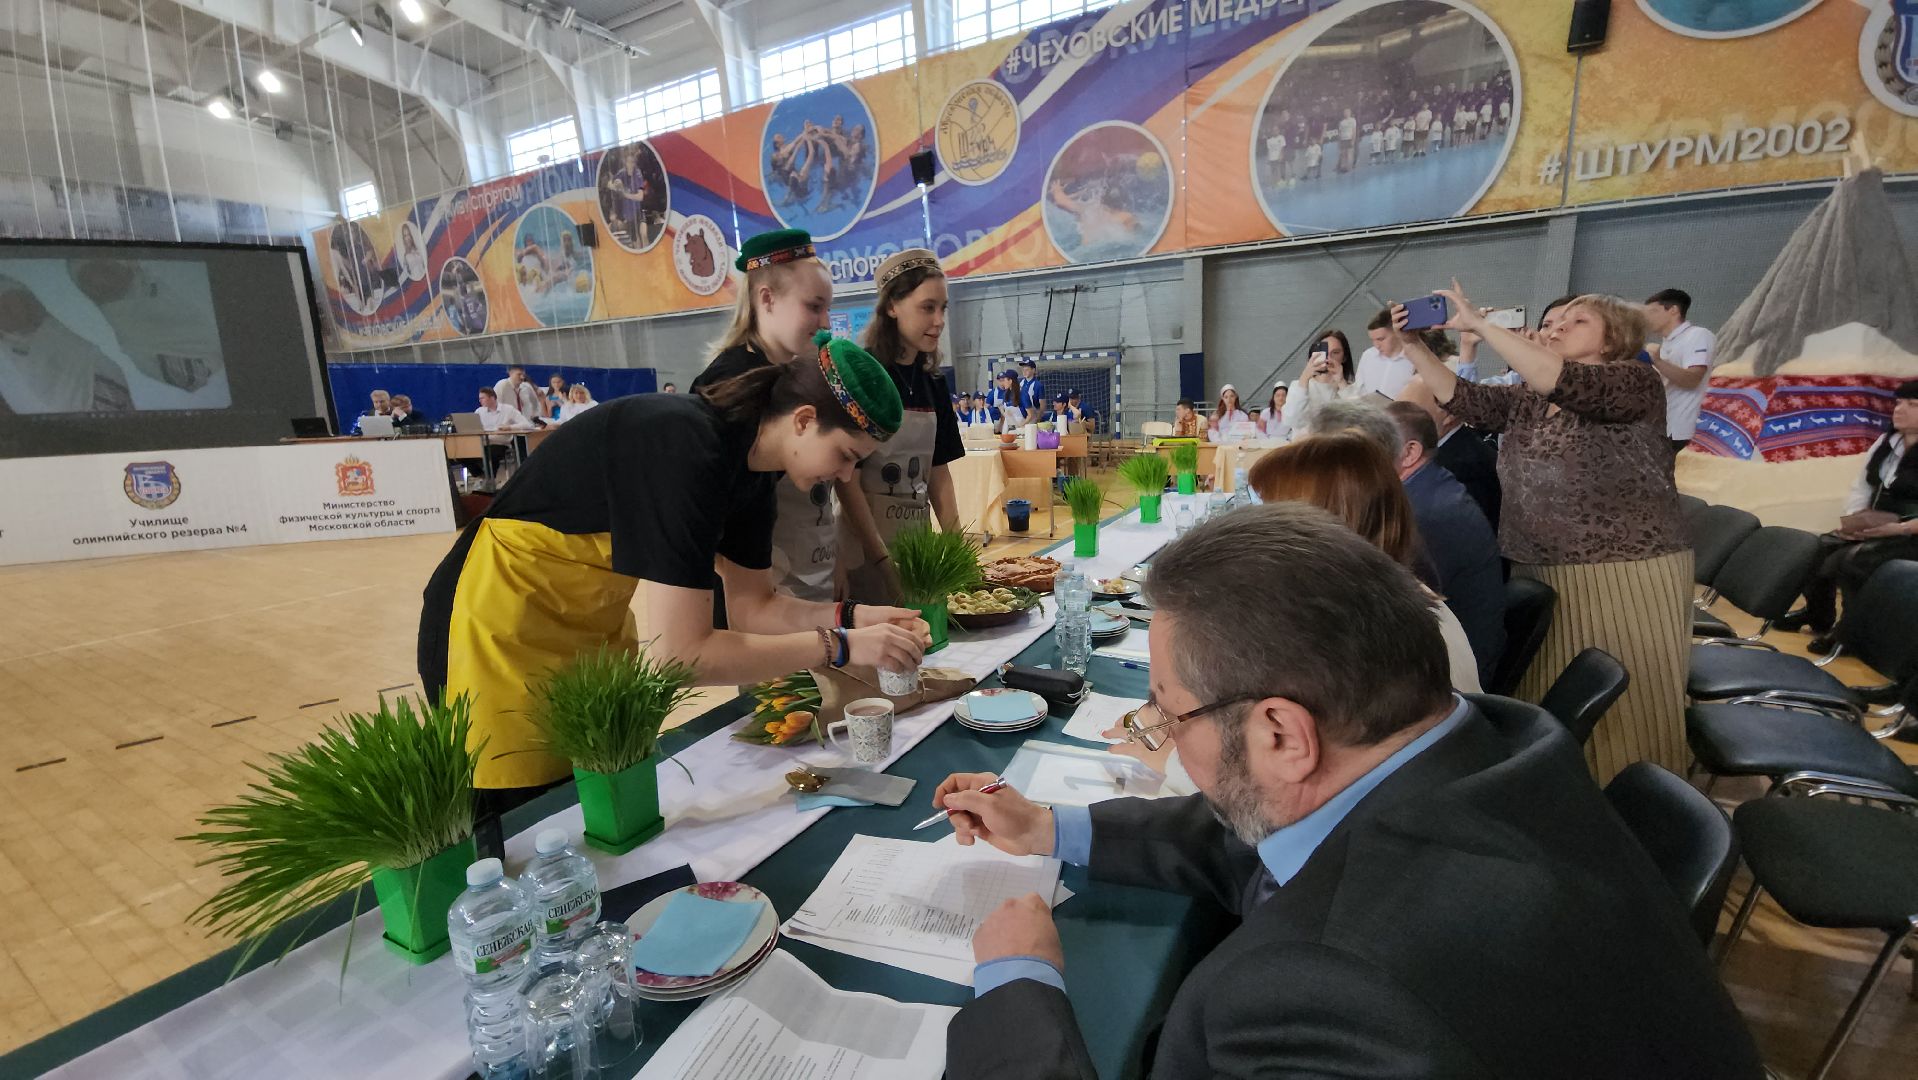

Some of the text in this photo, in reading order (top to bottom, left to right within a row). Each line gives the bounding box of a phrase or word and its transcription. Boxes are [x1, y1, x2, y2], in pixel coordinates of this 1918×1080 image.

[1006, 5, 1182, 75] #ЧЕХОВСКИЕ
[471, 184, 522, 211] СПОРТОМ
[323, 500, 395, 510] Министерство
[129, 516, 189, 528] Училище
[279, 511, 343, 524] физической
[345, 510, 395, 521] культуры
[406, 507, 441, 518] спорта
[309, 518, 415, 532] Московской области
[72, 523, 248, 546] олимпийского резерва №4
